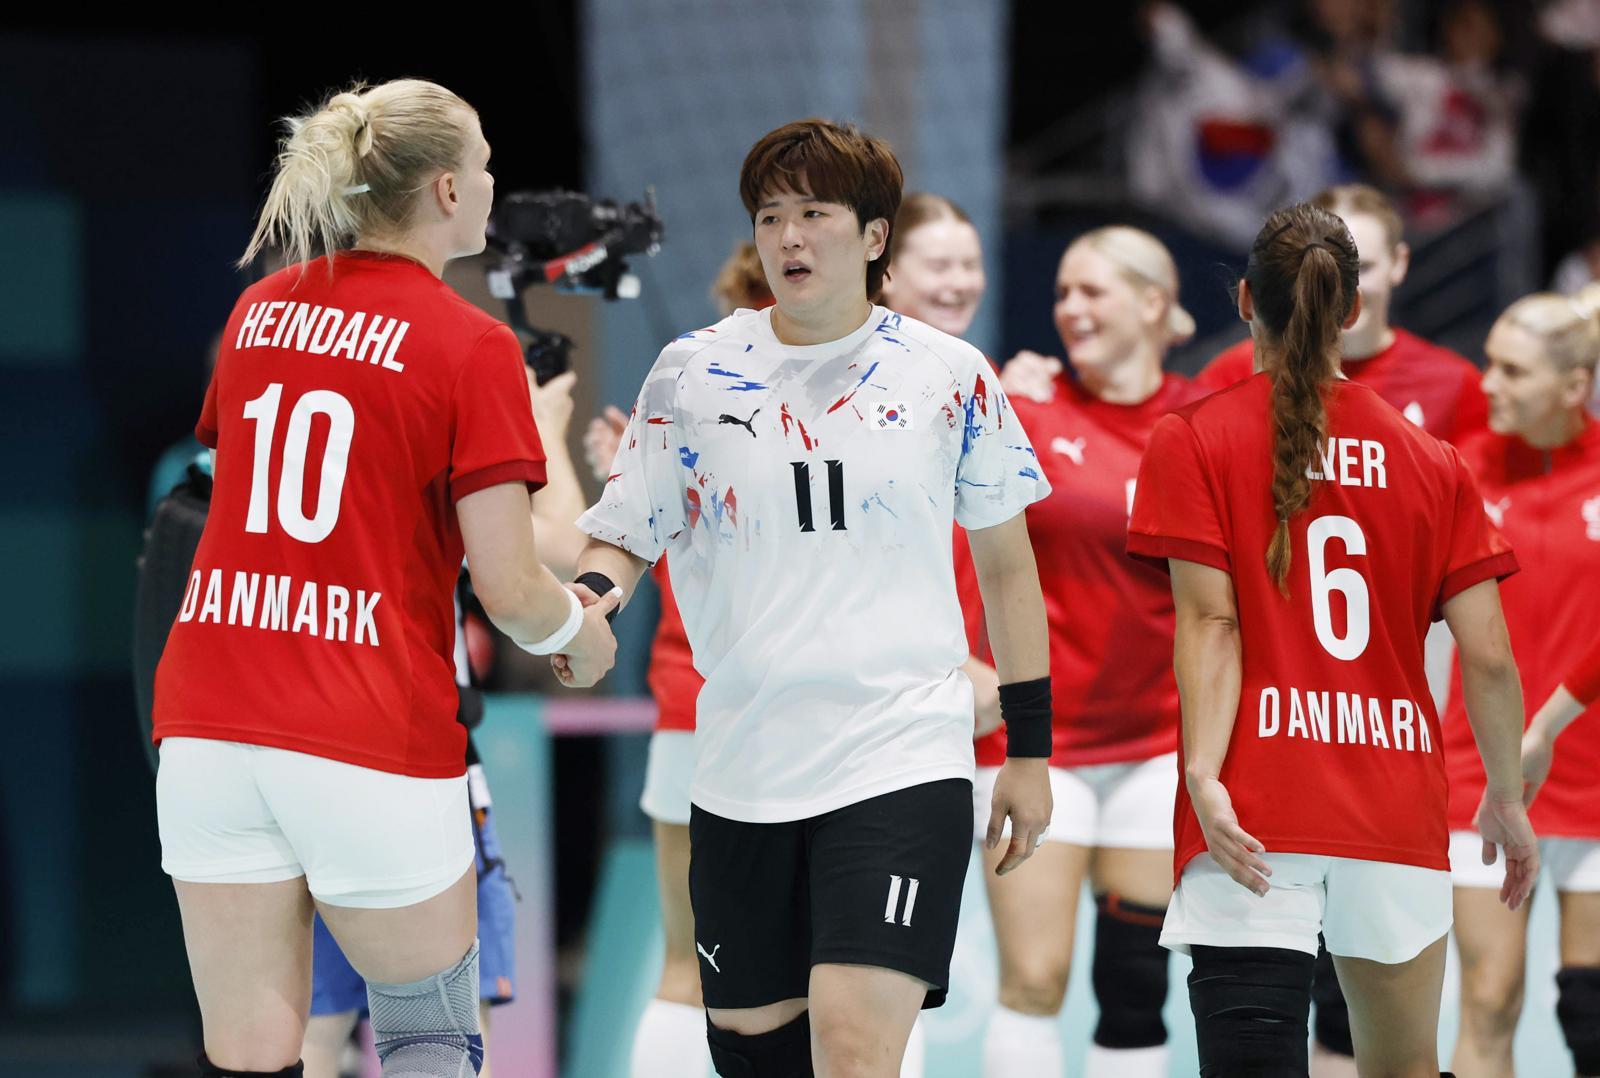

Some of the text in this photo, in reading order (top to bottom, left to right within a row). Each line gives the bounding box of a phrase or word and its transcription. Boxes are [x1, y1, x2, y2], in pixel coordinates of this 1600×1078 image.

[235, 301, 410, 373] HEINDAHL
[243, 382, 355, 544] 10
[789, 460, 848, 533] 11
[179, 568, 382, 647] DANMARK
[1307, 515, 1370, 661] 6
[884, 874, 920, 927] 11
